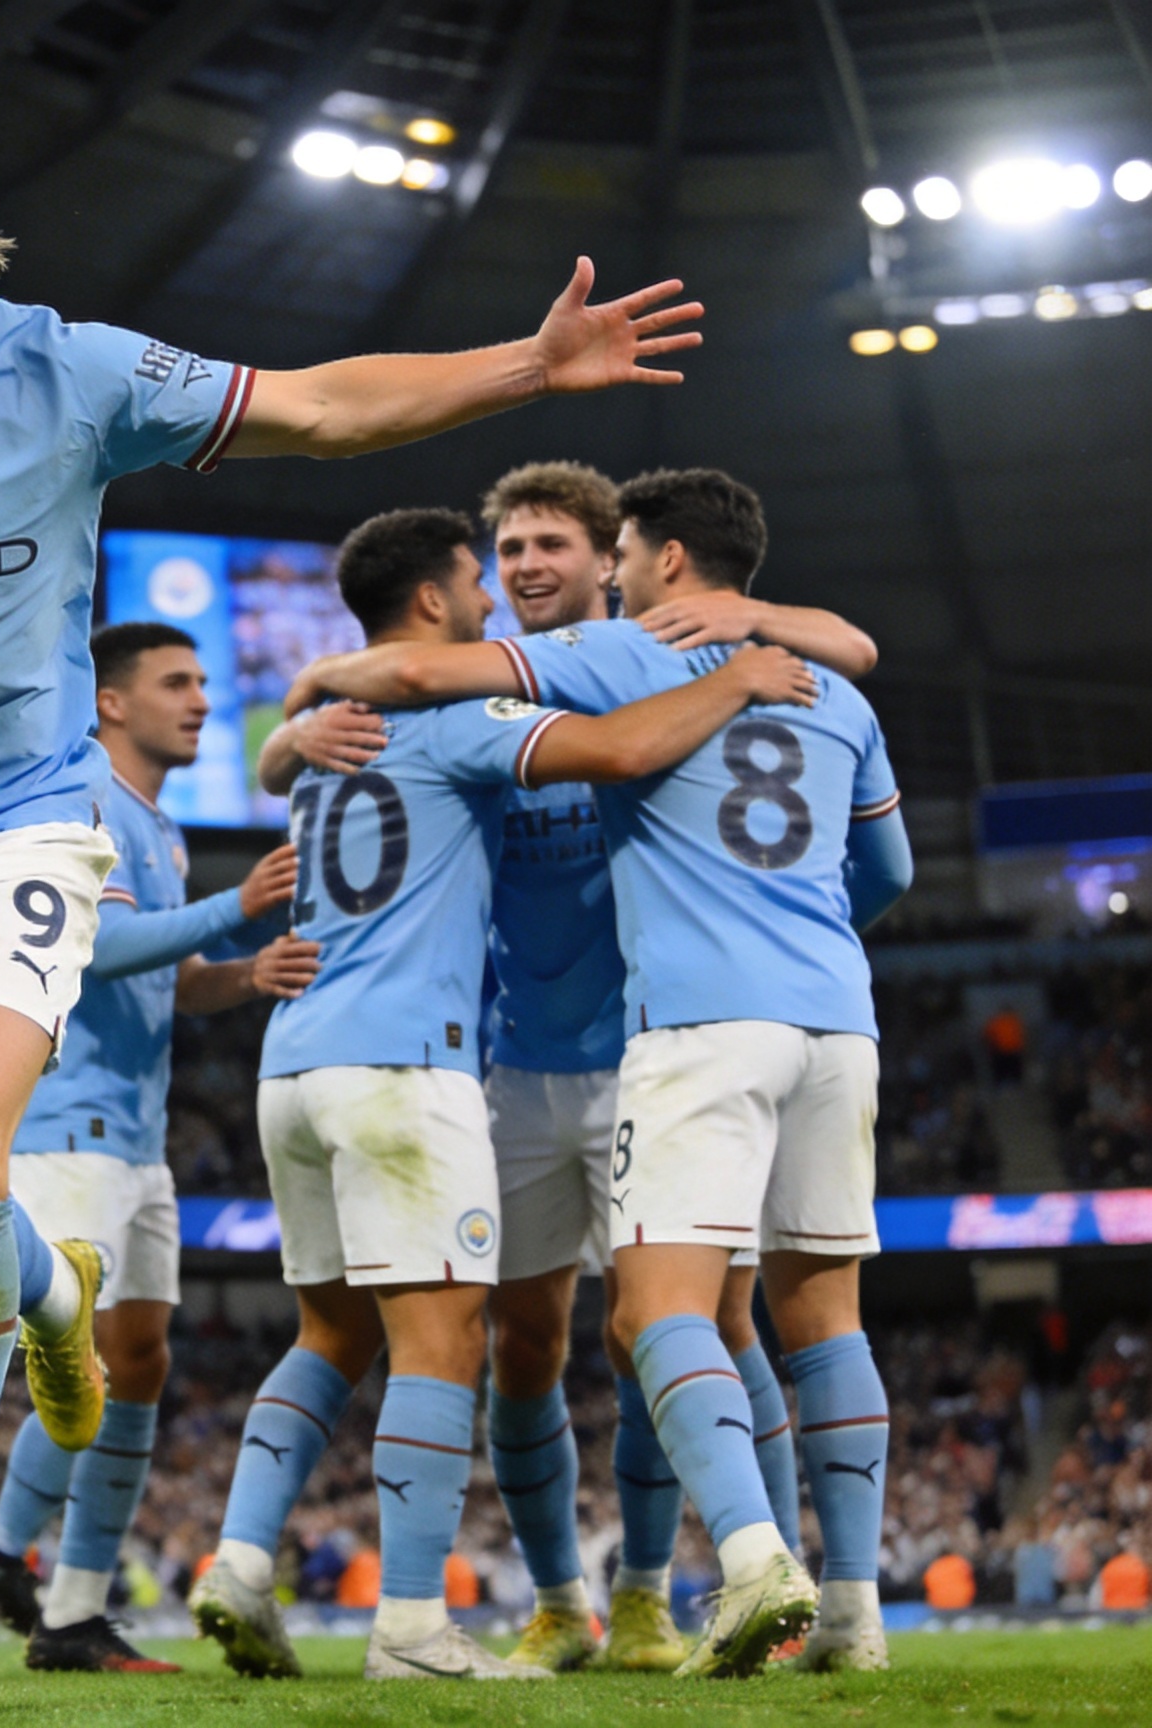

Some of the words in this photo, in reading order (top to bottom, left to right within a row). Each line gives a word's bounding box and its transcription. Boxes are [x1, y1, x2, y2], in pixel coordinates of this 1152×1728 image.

[292, 770, 409, 926] 10
[717, 720, 813, 870] 8
[13, 879, 66, 949] 9
